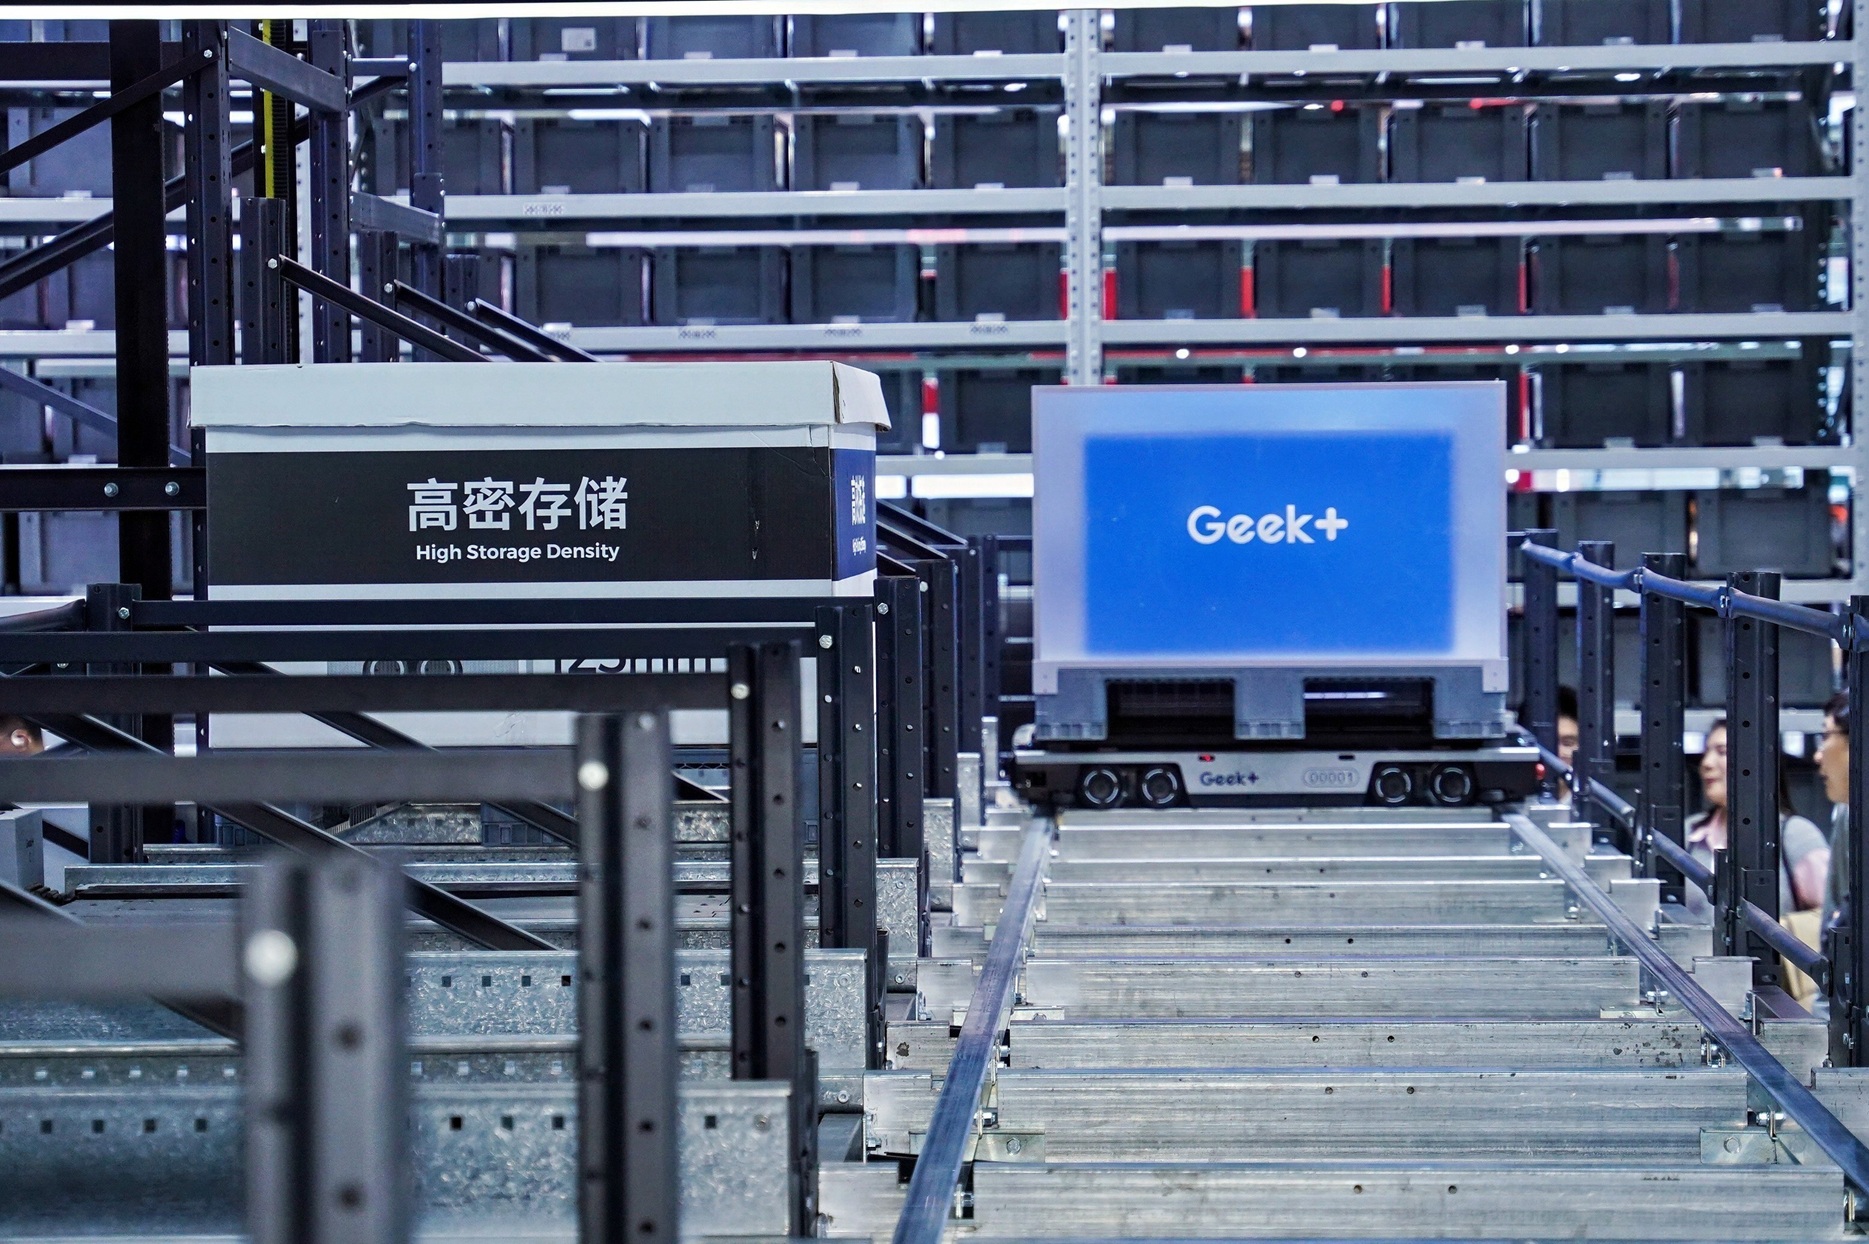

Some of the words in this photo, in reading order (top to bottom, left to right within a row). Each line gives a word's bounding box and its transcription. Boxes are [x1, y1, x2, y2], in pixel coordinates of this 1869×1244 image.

[407, 476, 628, 531] 高密存储
[1187, 505, 1349, 545] Geek+
[416, 544, 462, 563] High
[466, 545, 542, 563] Storage
[546, 543, 620, 562] Density
[1200, 771, 1259, 786] Geek+
